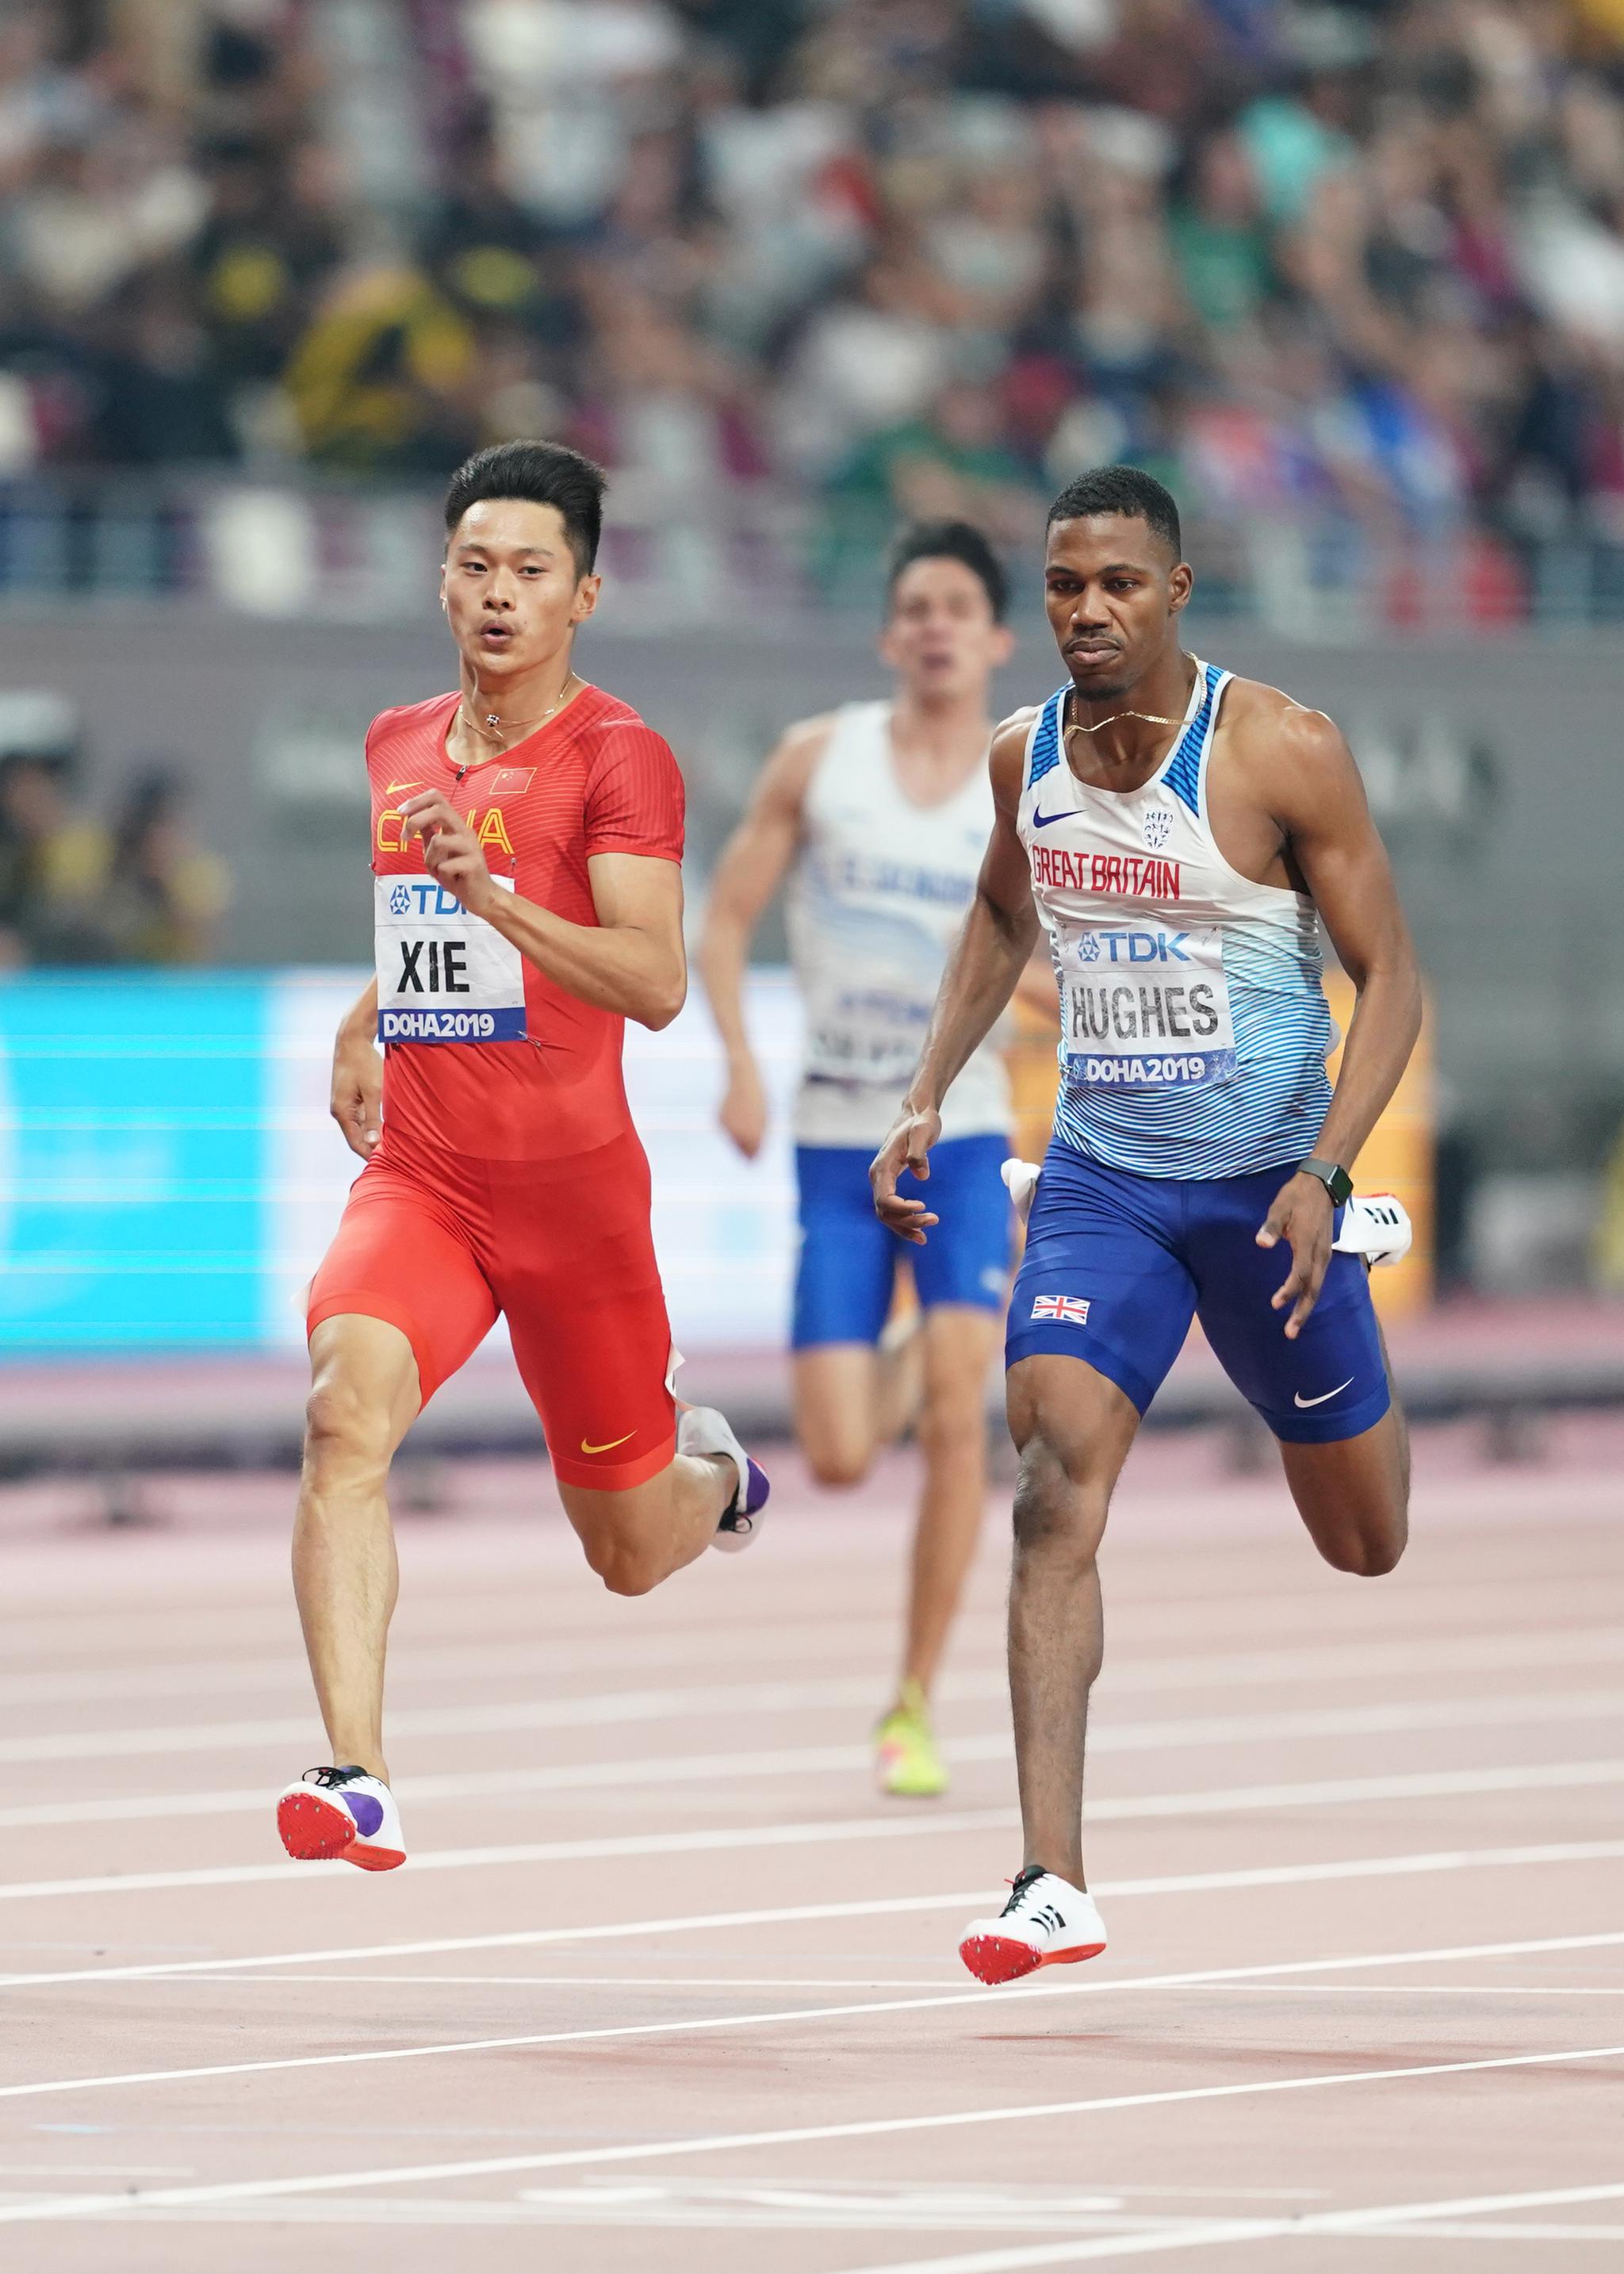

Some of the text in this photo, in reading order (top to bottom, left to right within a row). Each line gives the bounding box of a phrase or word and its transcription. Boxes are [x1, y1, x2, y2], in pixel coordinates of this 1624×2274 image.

[1032, 846, 1180, 899] GREAT BRITAIN
[412, 885, 466, 915] TD
[1098, 933, 1192, 961] TDK
[397, 941, 470, 992] XIE
[384, 1013, 495, 1037] DOHA2019
[1071, 984, 1219, 1039] HUGHES
[1087, 1056, 1205, 1083] DOHA2019
